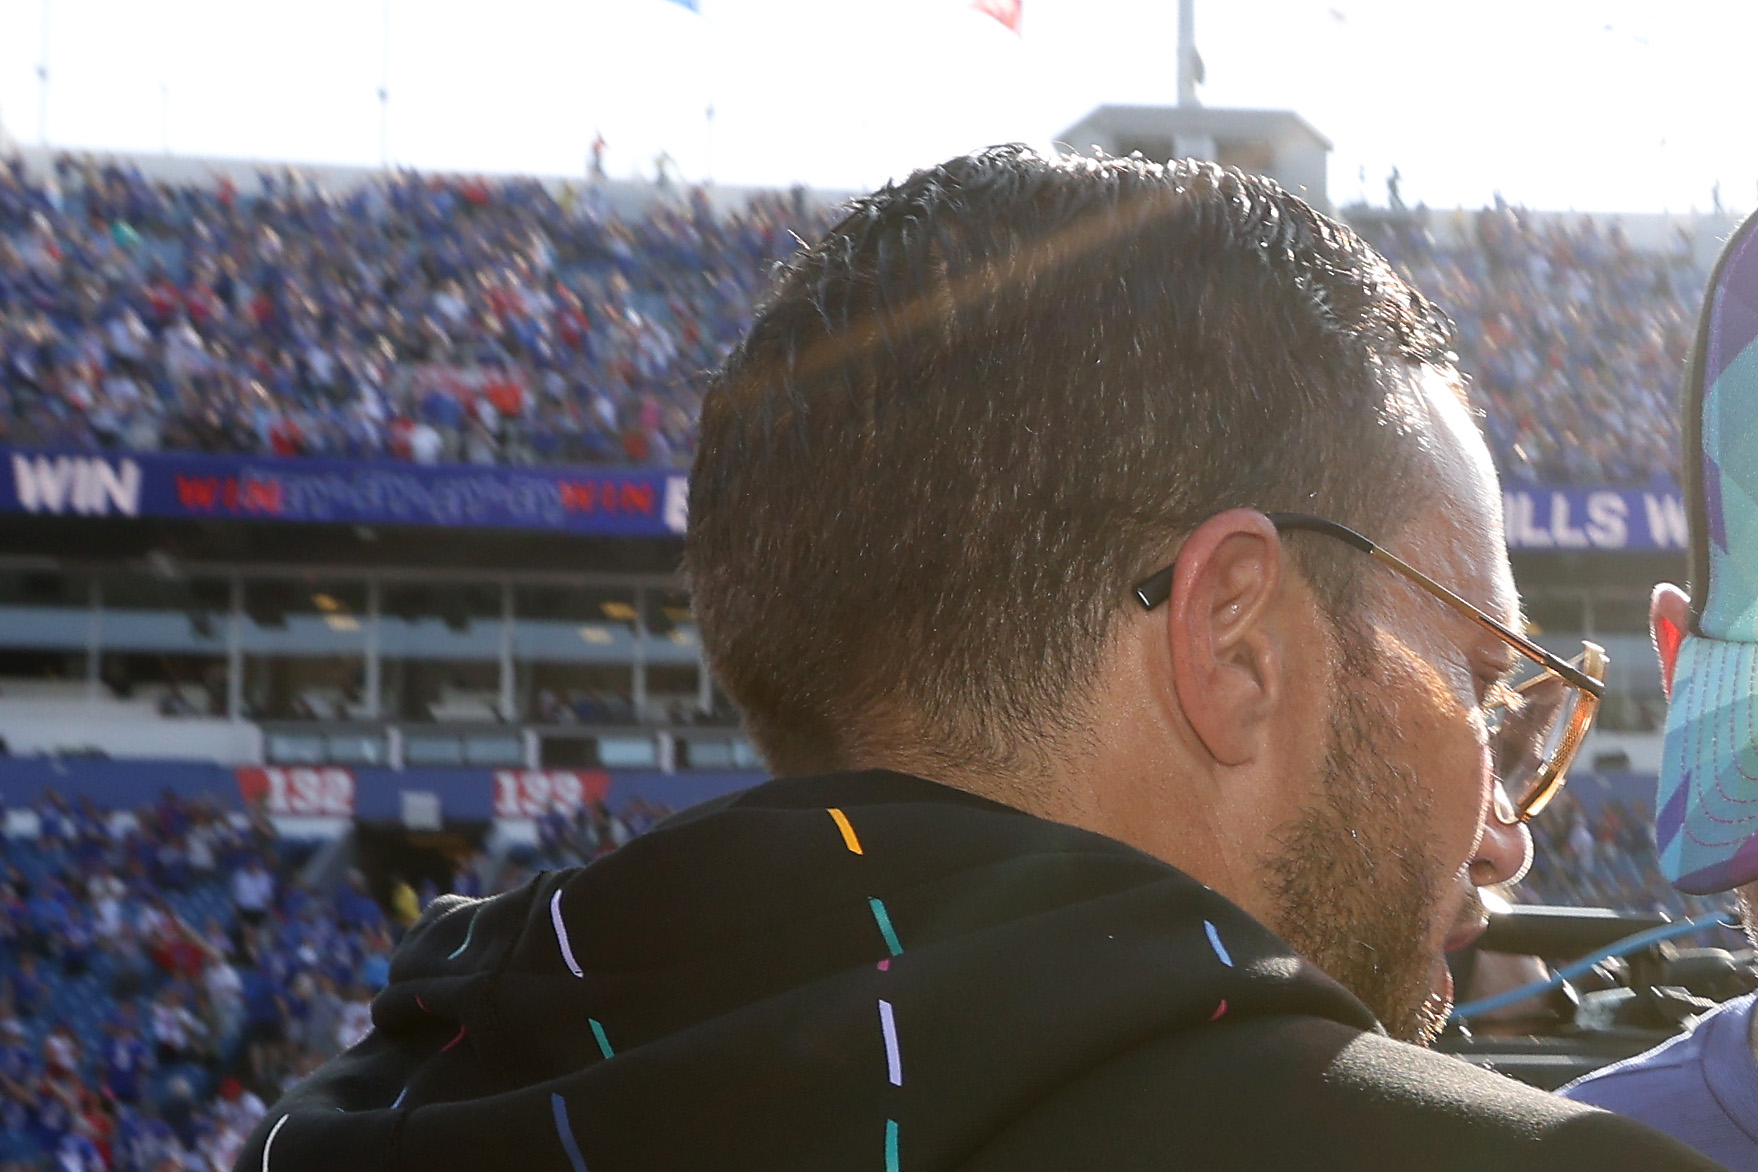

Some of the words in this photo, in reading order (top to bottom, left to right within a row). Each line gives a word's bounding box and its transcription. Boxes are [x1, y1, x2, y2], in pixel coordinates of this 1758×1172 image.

[12, 454, 142, 517] WIN
[175, 475, 283, 514] WIN
[559, 478, 654, 513] WIN
[1503, 490, 1629, 548] ILLS
